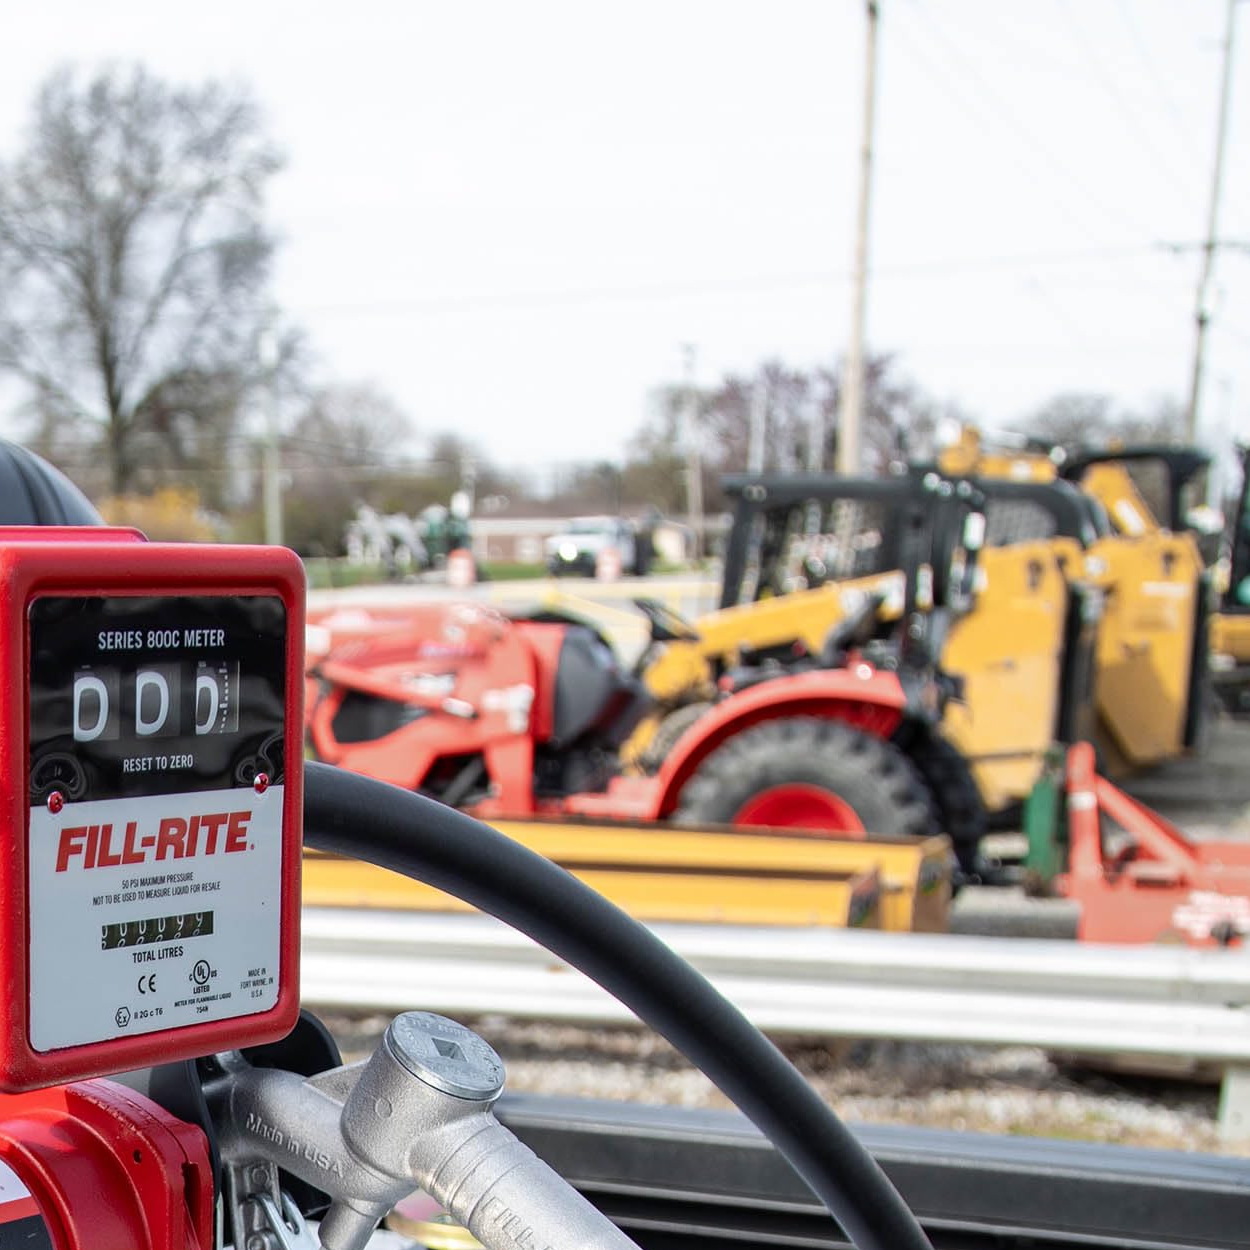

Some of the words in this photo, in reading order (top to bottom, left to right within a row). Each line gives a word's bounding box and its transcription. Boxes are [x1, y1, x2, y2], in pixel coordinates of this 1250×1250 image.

[98, 631, 143, 650] SERIES
[146, 630, 180, 649] 800C
[184, 629, 225, 647] METER
[123, 758, 152, 773] RESET
[155, 756, 168, 770] TO
[170, 754, 194, 769] ZERO
[122, 880, 129, 889] 50
[130, 879, 139, 888] PSI
[140, 876, 166, 888] MAXIMUM
[166, 872, 194, 883] PRESSURE
[93, 896, 104, 906] NOT
[105, 895, 113, 904] TO
[113, 894, 121, 903] BE
[122, 892, 137, 902] USED
[138, 891, 145, 900] TO
[146, 888, 170, 899] MEASURE
[172, 885, 189, 895] LIQUID
[190, 883, 200, 893] FOR
[201, 881, 221, 891] RESALE
[132, 950, 156, 963] TOTAL
[158, 946, 184, 960] LITRES
[248, 968, 260, 977] MADE
[193, 985, 210, 994] LISTED
[155, 1008, 164, 1016] T6
[304, 1143, 344, 1179] USA
